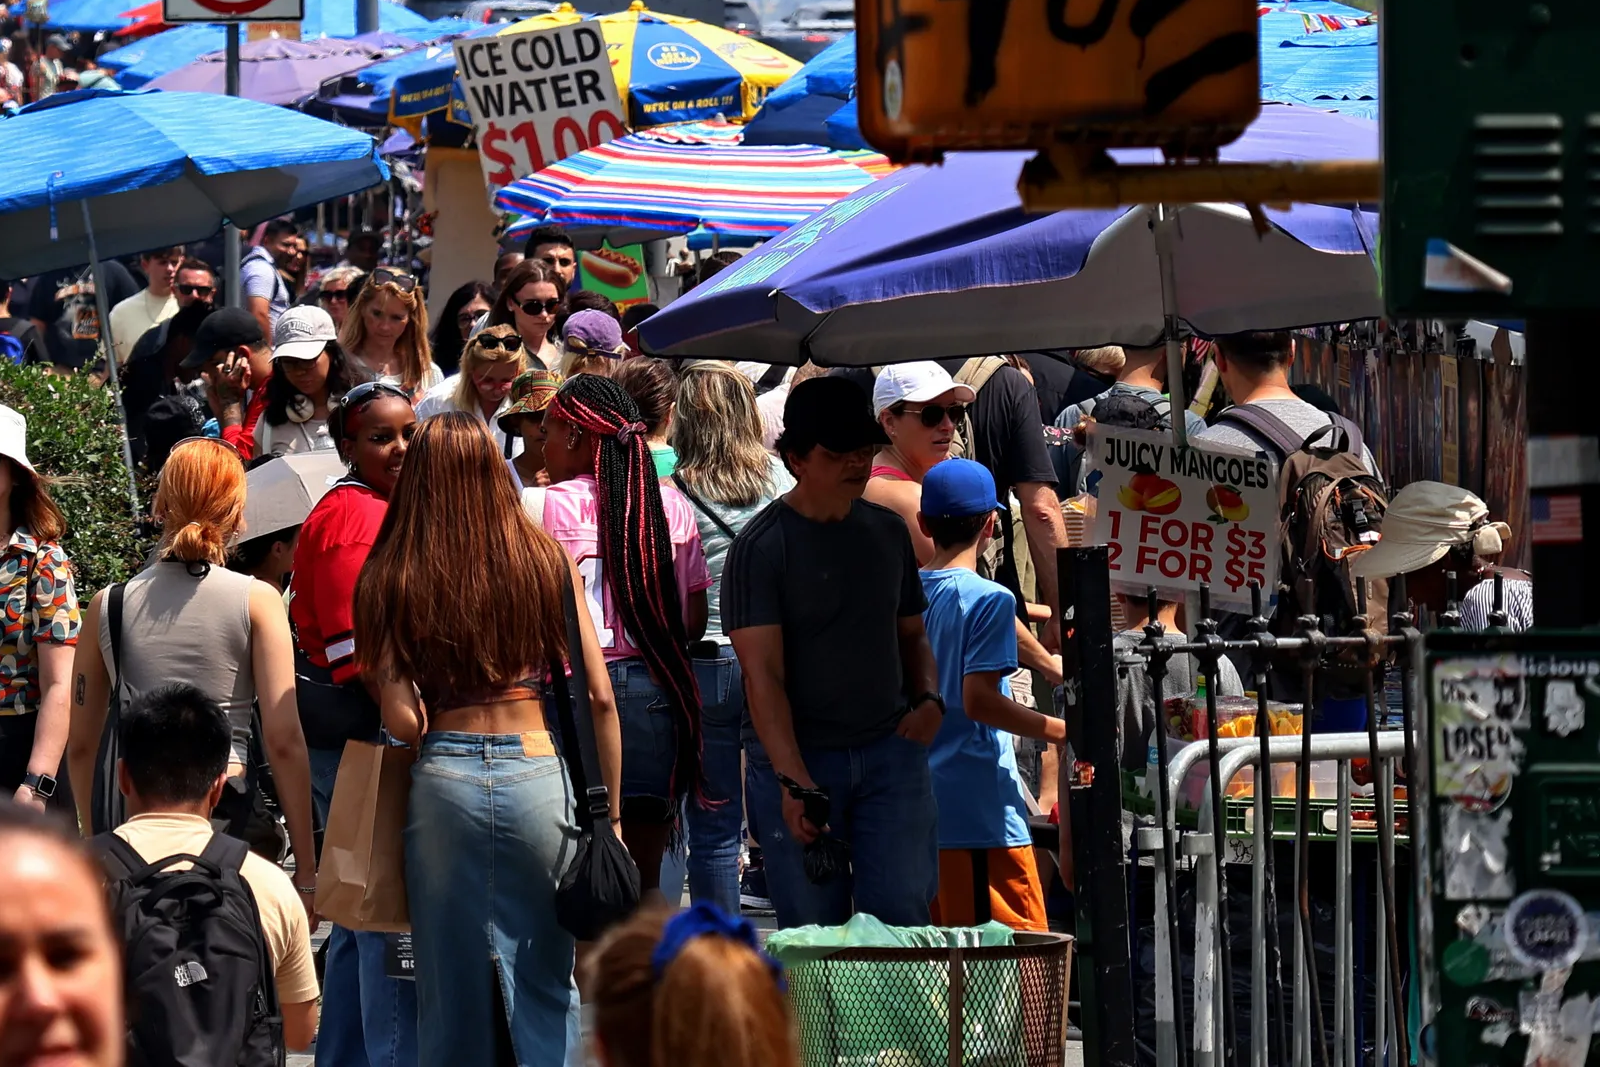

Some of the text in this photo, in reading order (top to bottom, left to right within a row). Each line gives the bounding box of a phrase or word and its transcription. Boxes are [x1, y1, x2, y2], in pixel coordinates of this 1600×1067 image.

[458, 27, 601, 80] ICE COLD
[470, 69, 605, 119] WATER
[696, 97, 719, 109] ROLL
[1105, 437, 1269, 489] JUICY MANGOES
[1108, 510, 1267, 560] 1 FOR $3
[1108, 542, 1266, 592] 2 FOR $5
